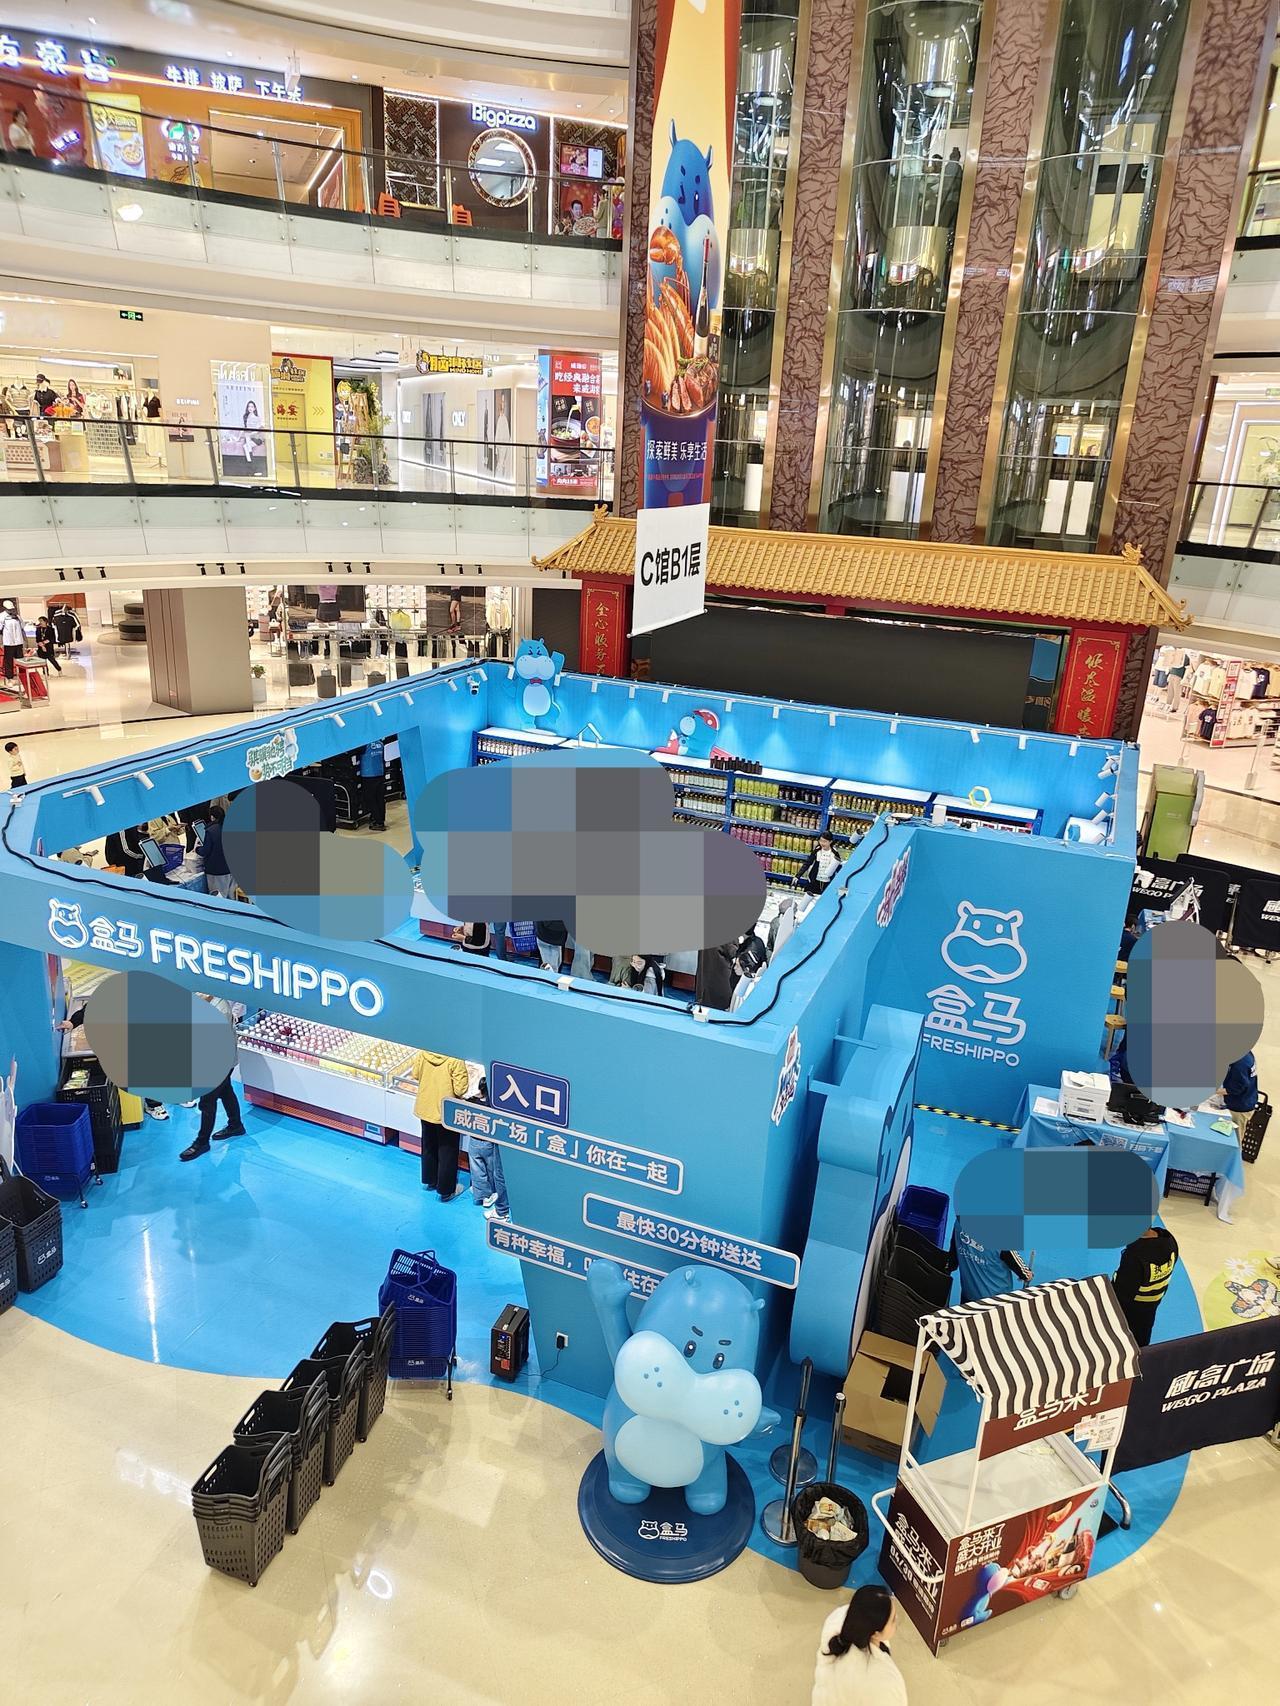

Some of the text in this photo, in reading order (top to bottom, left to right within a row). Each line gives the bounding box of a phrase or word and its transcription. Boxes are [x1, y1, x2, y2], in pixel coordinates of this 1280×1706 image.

[471, 102, 536, 131] Bigpizza
[646, 439, 708, 461] 探索鲜美 乐享生活
[641, 541, 701, 586] C馆B1层
[89, 915, 145, 958] 盒马
[150, 928, 385, 1017] FRESHIPPO
[924, 984, 1027, 1046] 盒马
[922, 1033, 1020, 1067] FRESHIPPO
[499, 1074, 561, 1117] 入口
[453, 1109, 669, 1185] 威高广场「盒」你在一起
[616, 1210, 762, 1272] 最快30分钟送达
[1160, 1377, 1268, 1413] WEGO PLAZA
[1164, 1351, 1277, 1399] 威高广场
[660, 1521, 688, 1536] 盒马
[958, 1523, 1006, 1551] 盒马来了
[890, 1544, 913, 1582] 04/30
